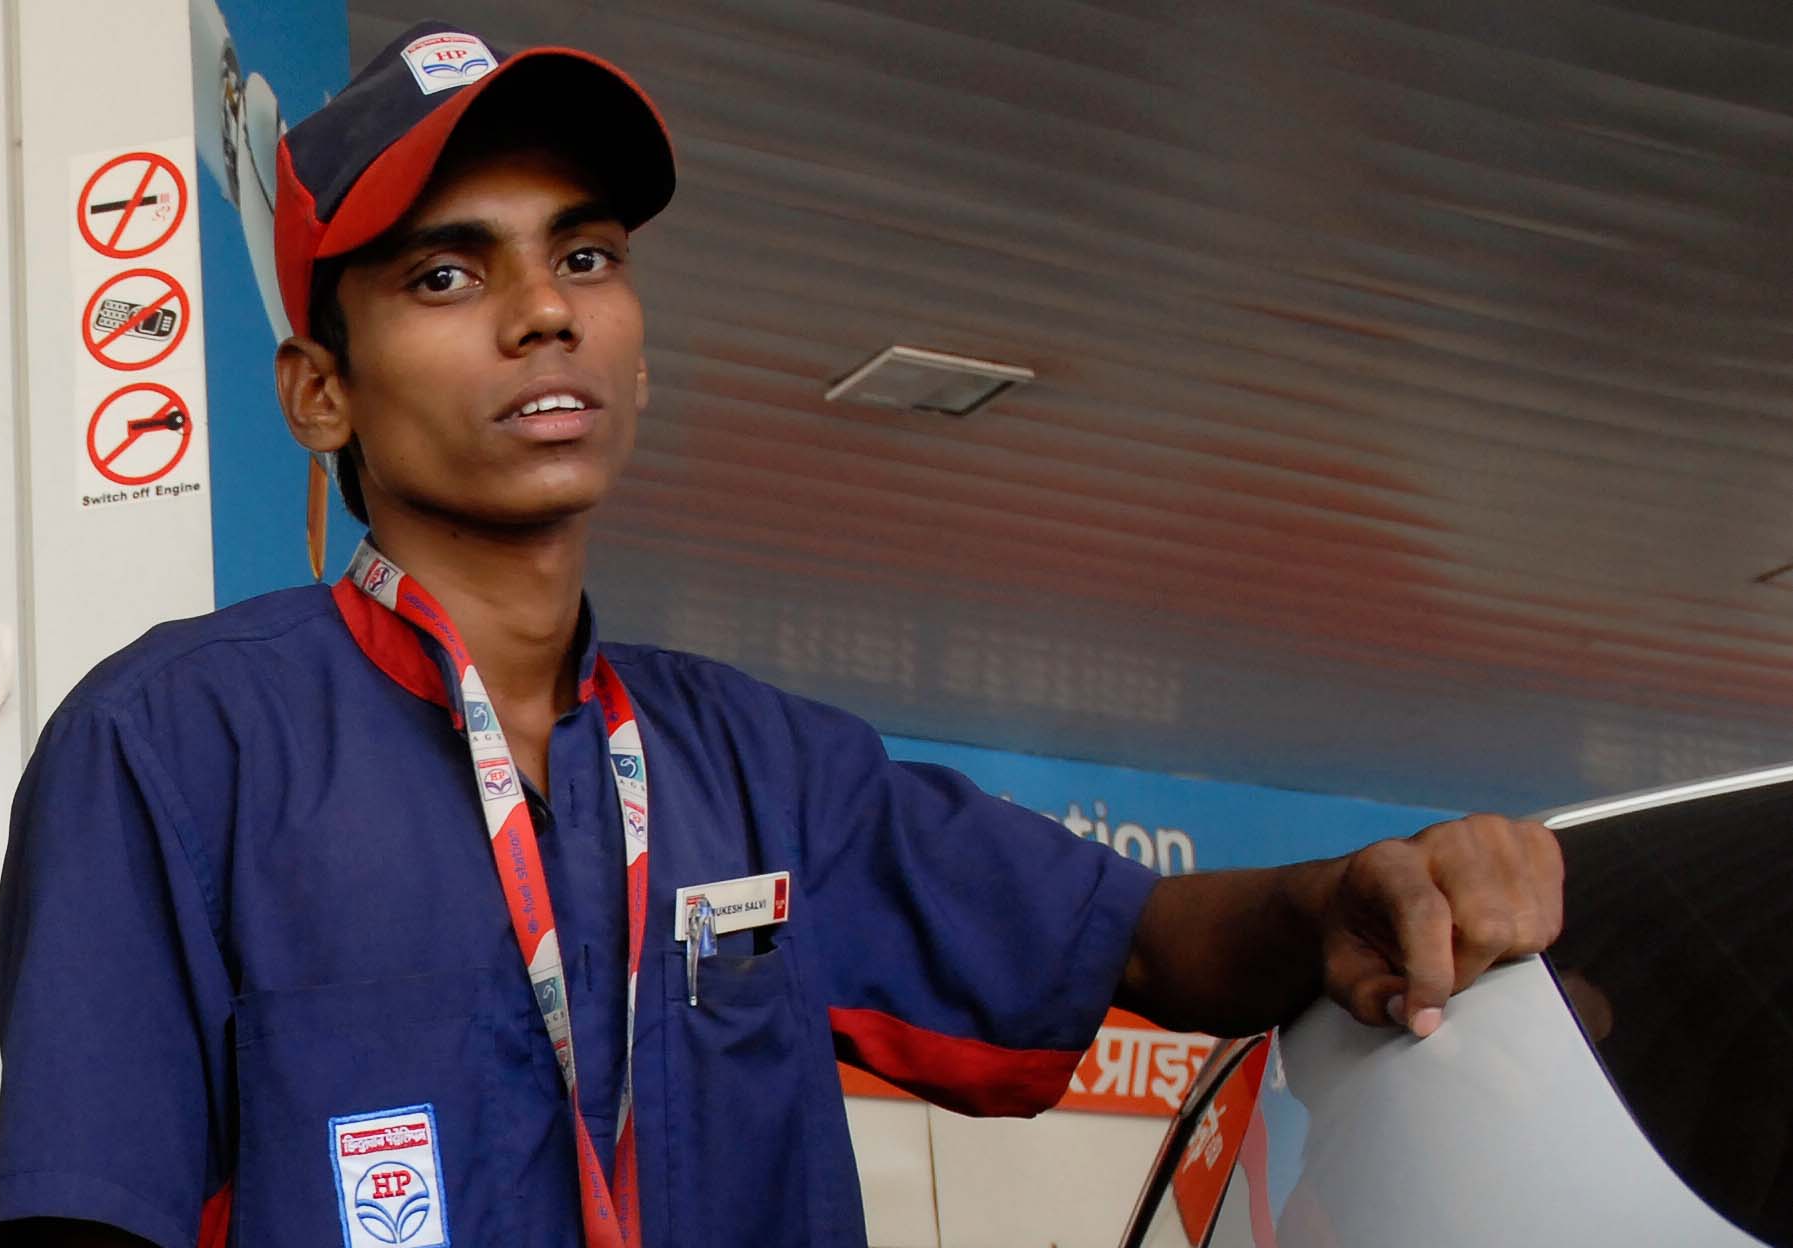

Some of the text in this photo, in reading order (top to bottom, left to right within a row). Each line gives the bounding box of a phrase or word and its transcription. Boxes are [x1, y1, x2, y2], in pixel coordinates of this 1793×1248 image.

[435, 49, 467, 62] HP
[82, 482, 201, 506] Switch off Engine
[710, 904, 743, 917] UKESH
[744, 899, 767, 912] SALVI
[371, 1170, 413, 1199] HP
